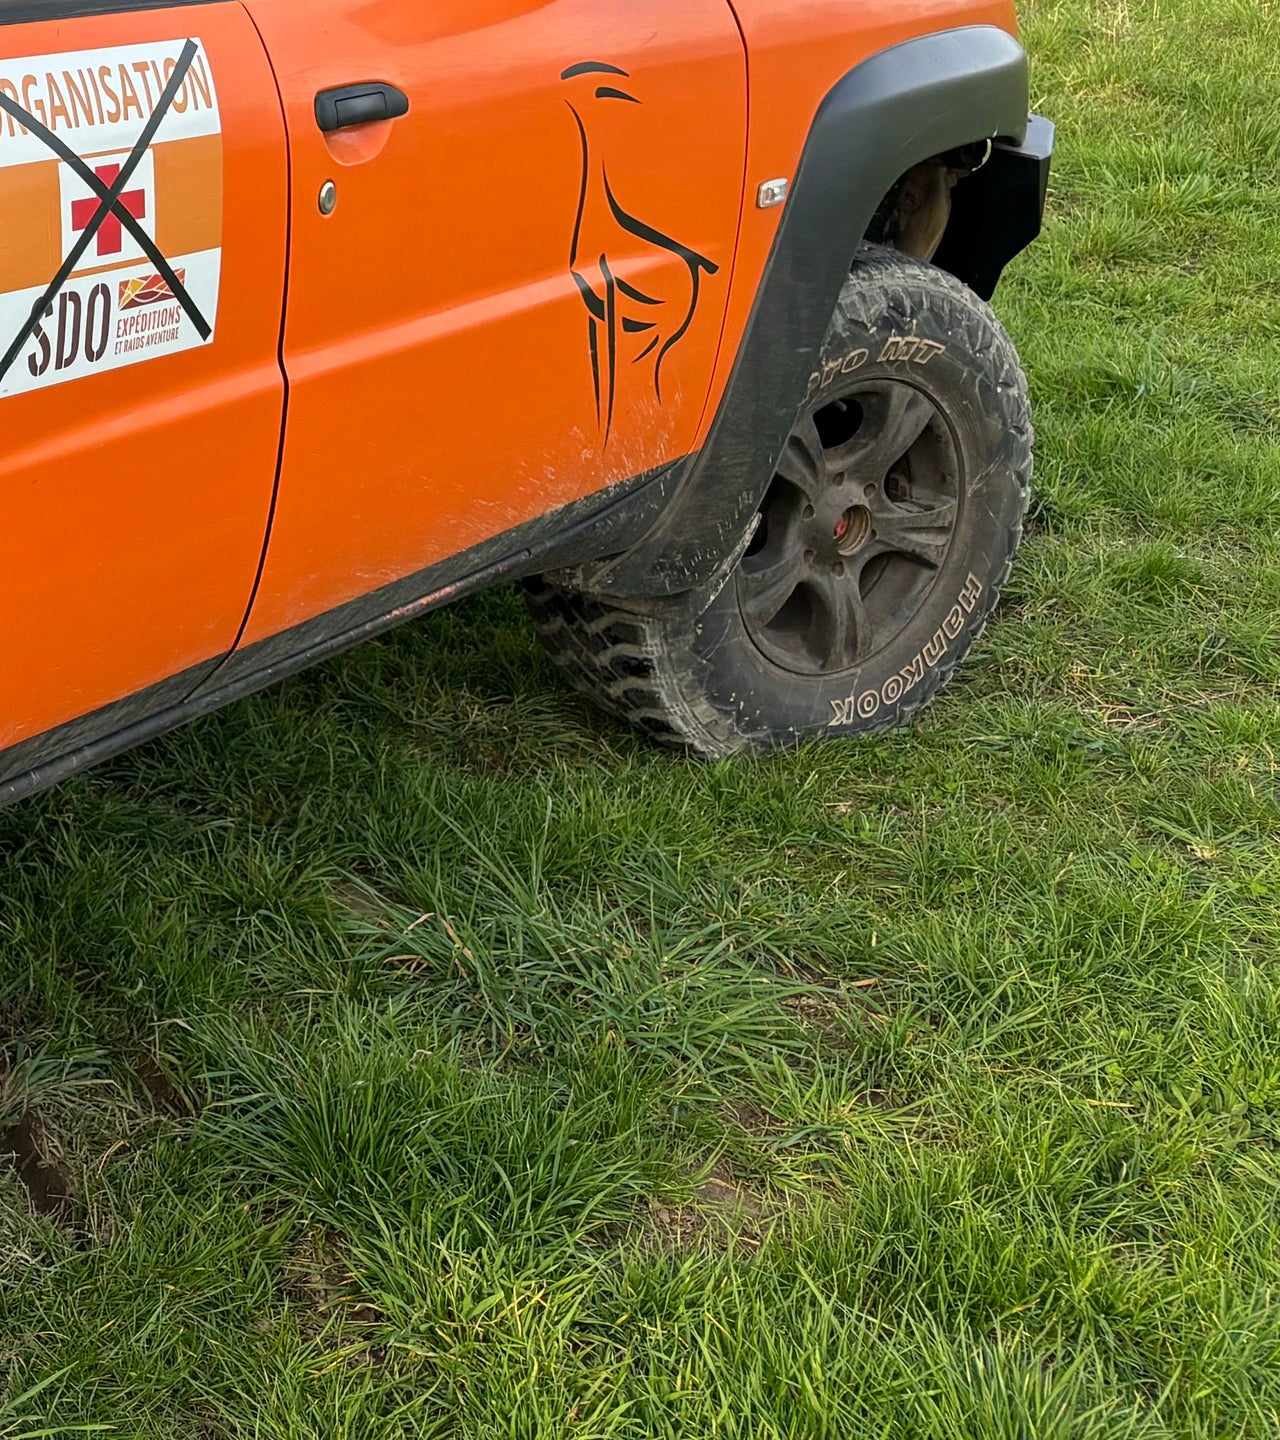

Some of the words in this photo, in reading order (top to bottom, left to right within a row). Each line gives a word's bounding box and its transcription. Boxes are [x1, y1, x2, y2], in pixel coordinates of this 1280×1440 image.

[116, 305, 181, 338] EXPÉDITIONS
[115, 341, 123, 355] ET
[124, 334, 145, 352] RAIDS
[145, 327, 180, 347] AVENTURE
[876, 336, 946, 364] MT
